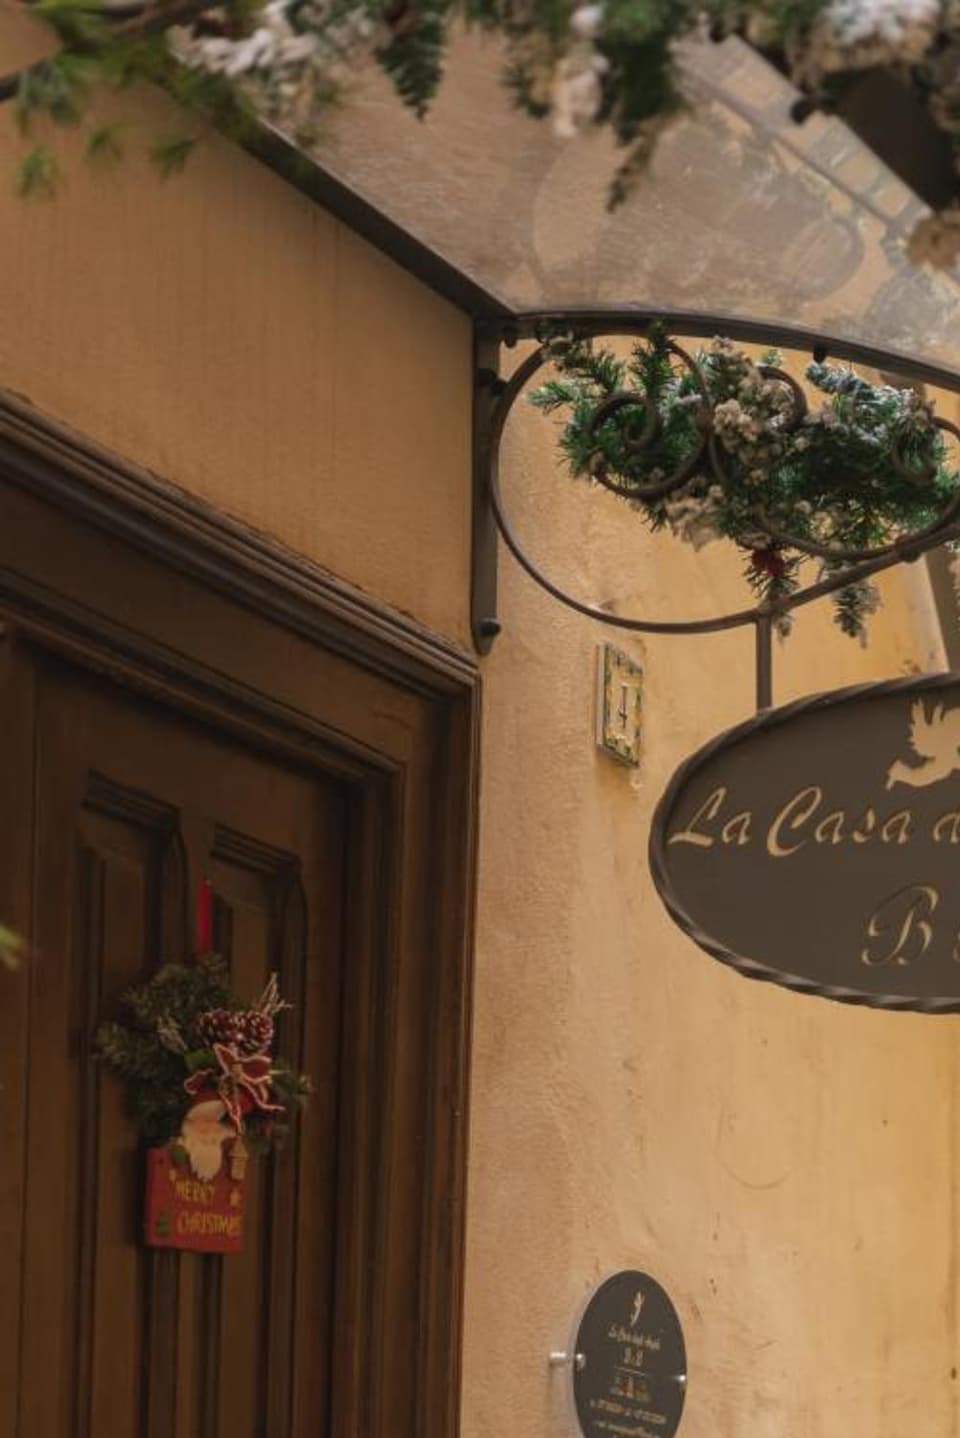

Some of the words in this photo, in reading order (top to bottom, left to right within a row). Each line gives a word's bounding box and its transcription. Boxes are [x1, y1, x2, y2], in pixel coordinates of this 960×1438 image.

[669, 787, 752, 846] La
[766, 786, 911, 858] Casa
[861, 884, 940, 966] B
